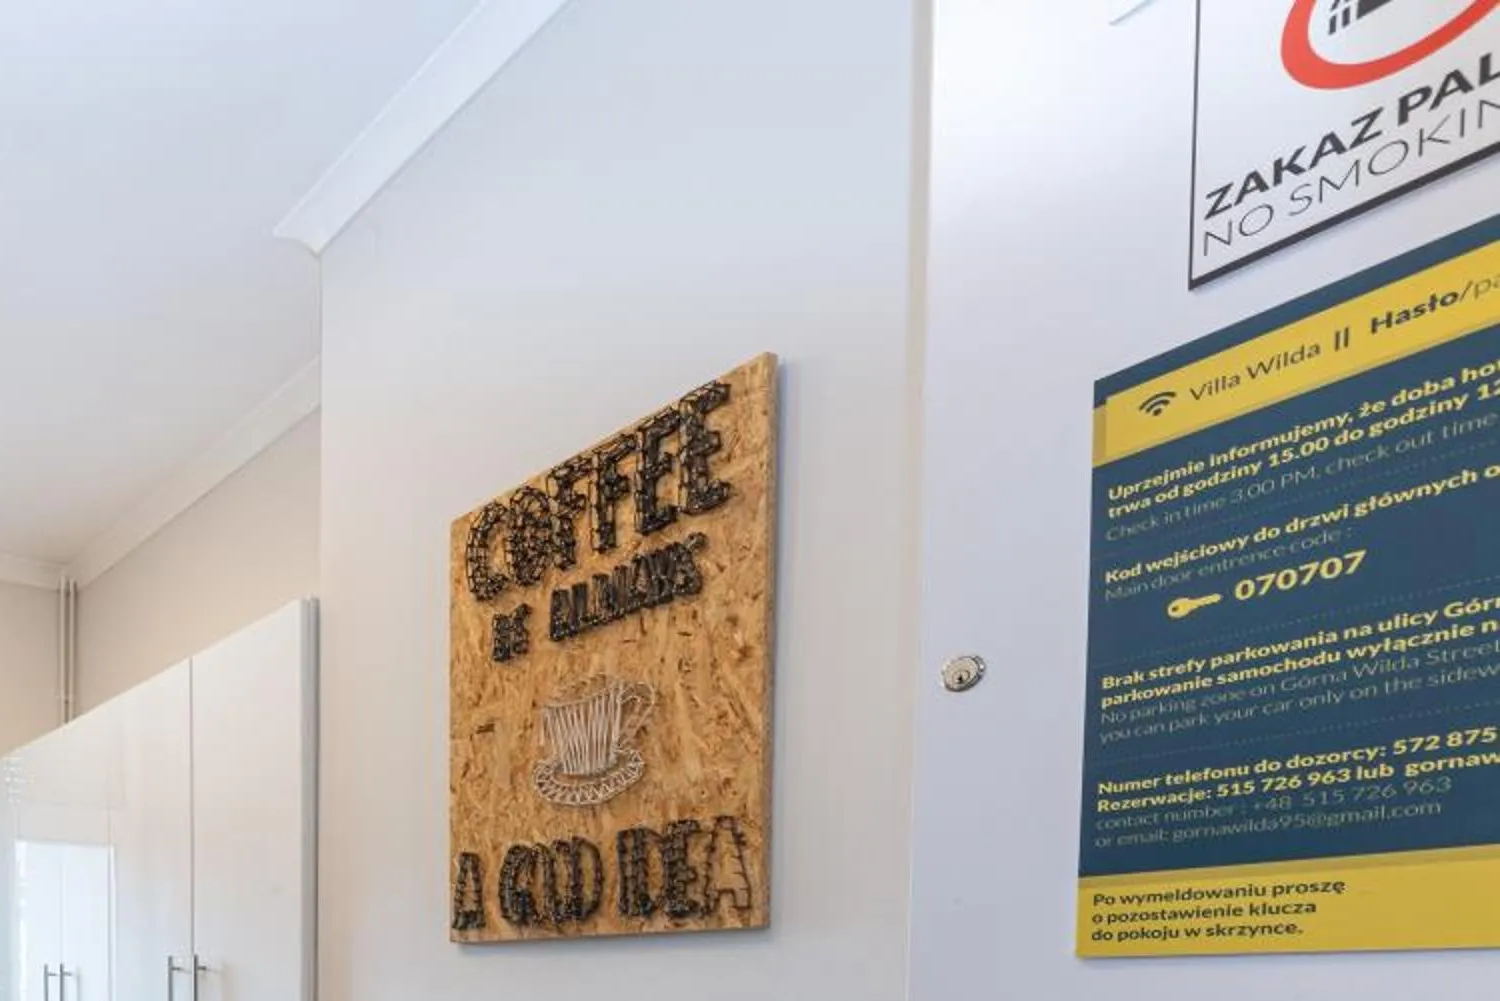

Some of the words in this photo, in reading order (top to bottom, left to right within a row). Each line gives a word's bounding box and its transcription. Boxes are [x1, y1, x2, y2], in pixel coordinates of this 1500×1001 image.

[1204, 106, 1384, 220] ZAKAZ
[1203, 203, 1274, 256] NO
[1189, 374, 1241, 401] Villa
[1246, 344, 1321, 379] Wilda
[1107, 460, 1205, 499] Uprzejmie
[1390, 376, 1456, 406] doba
[1107, 498, 1151, 519] trwa
[1155, 484, 1179, 503] od
[1183, 461, 1262, 497] godziny
[1268, 437, 1329, 468] 15.00
[1334, 428, 1365, 446] do
[1368, 393, 1469, 437] godziny
[1395, 431, 1432, 453] out
[1442, 412, 1499, 439] time
[466, 380, 731, 601] COFFEE
[1104, 563, 1142, 584] Kod
[1145, 534, 1250, 573] wejściowy
[1253, 527, 1281, 543] do
[1285, 503, 1349, 533] drzwi
[1354, 469, 1477, 518] głównych
[1234, 549, 1367, 600] 070707
[1101, 676, 1213, 709] parkowanie
[1216, 651, 1341, 685] samochodu
[1346, 623, 1476, 659] wyłącznie
[1481, 618, 1500, 634] n
[1102, 671, 1145, 689] Brak
[1148, 659, 1206, 680] strefy
[1211, 631, 1338, 670] parkowania
[1343, 624, 1373, 640] na
[1377, 609, 1439, 633] ulicy
[1097, 787, 1212, 813] Rezerwacje:
[1217, 781, 1255, 797] 515
[1261, 774, 1302, 792] 726
[1307, 768, 1351, 787] 963
[1356, 763, 1395, 780] lub
[1405, 752, 1500, 777] gornaw
[1098, 776, 1161, 795] Numer
[1165, 765, 1250, 786] telefonu
[1254, 758, 1282, 773] do
[1286, 745, 1387, 769] dozorcy:
[1392, 735, 1441, 755] 572
[1446, 726, 1497, 747] 875
[1402, 776, 1453, 795] 963
[452, 851, 486, 930] A
[498, 835, 604, 927] GOOD
[616, 814, 751, 918] IDEA
[1093, 892, 1115, 906] Po
[1119, 882, 1267, 906] wymeldowaniu
[1271, 880, 1346, 898] proszę
[1091, 914, 1104, 925] o
[1106, 903, 1243, 924] pozostawienie
[1249, 900, 1317, 917] klucza
[1091, 929, 1113, 941] do
[1117, 925, 1180, 943] pokoju
[1183, 926, 1202, 938] w
[1206, 921, 1304, 939] skrzynce.
